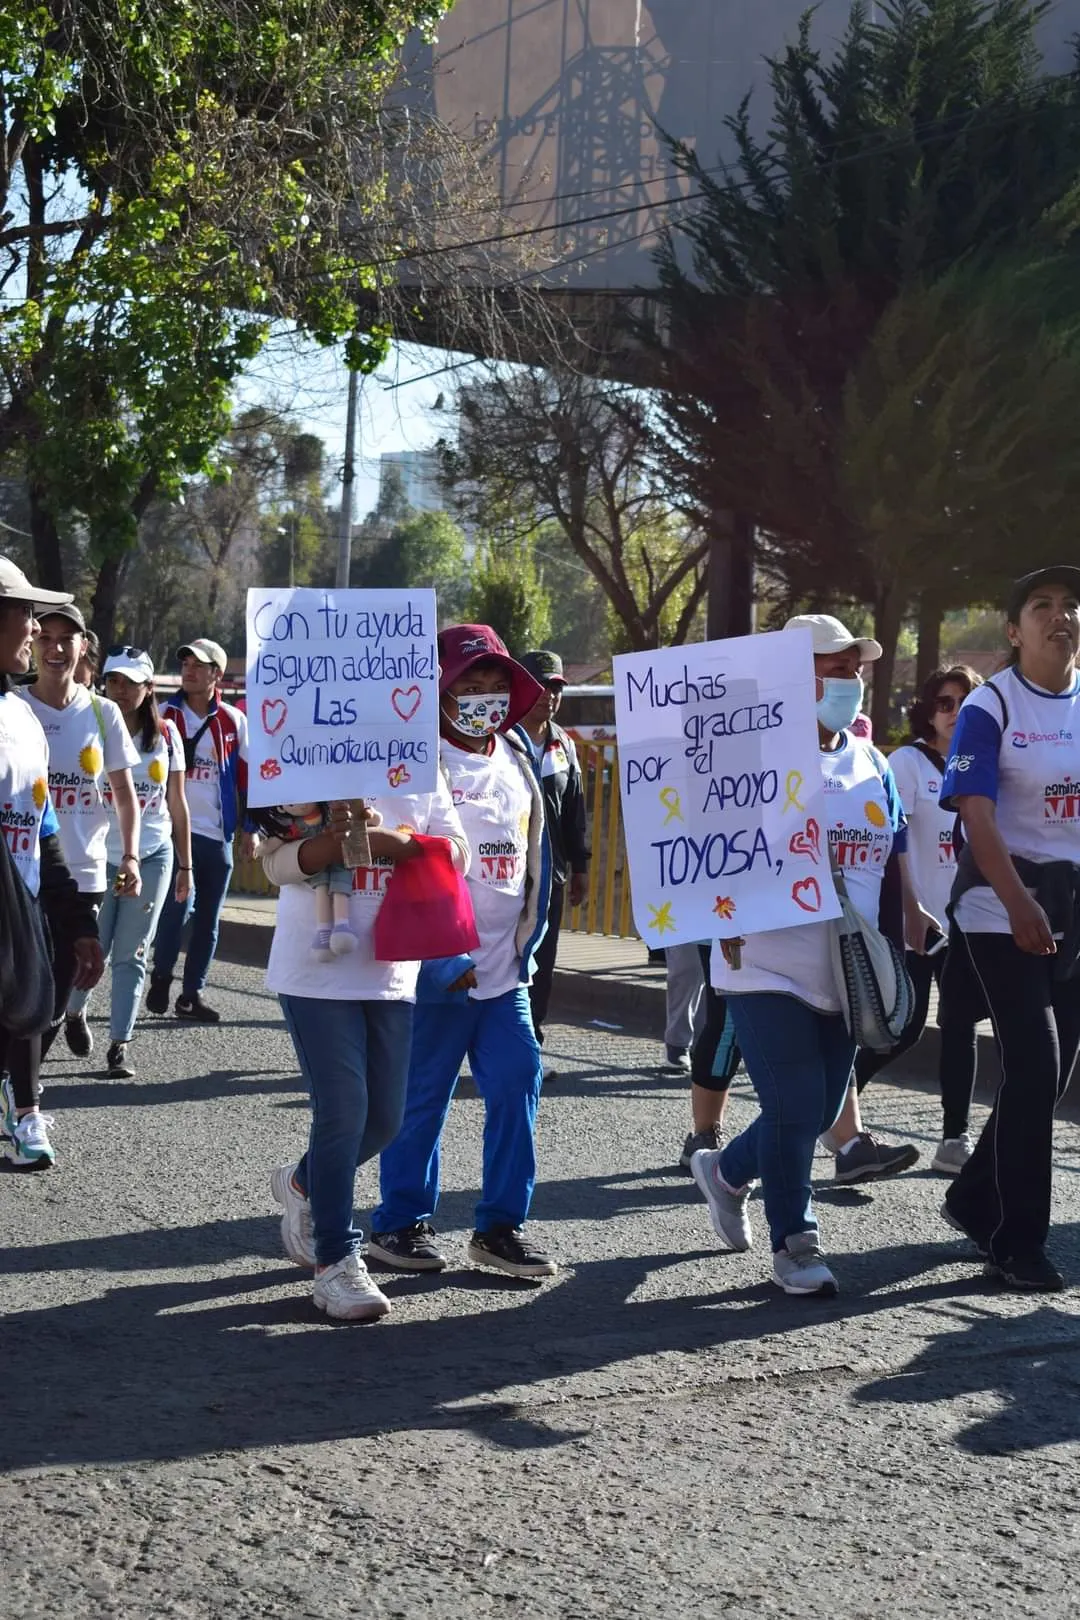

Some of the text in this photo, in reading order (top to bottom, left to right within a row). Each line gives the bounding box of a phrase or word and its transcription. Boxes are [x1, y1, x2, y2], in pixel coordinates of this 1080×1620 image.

[254, 601, 309, 641] Con
[356, 601, 426, 648] ayuda
[342, 643, 435, 681] adelante!
[313, 687, 357, 725] Las
[626, 665, 727, 711] Muchas
[627, 756, 672, 795] por
[693, 741, 713, 775] el
[703, 770, 778, 813] APOYO
[650, 829, 784, 888] TOYOSA,
